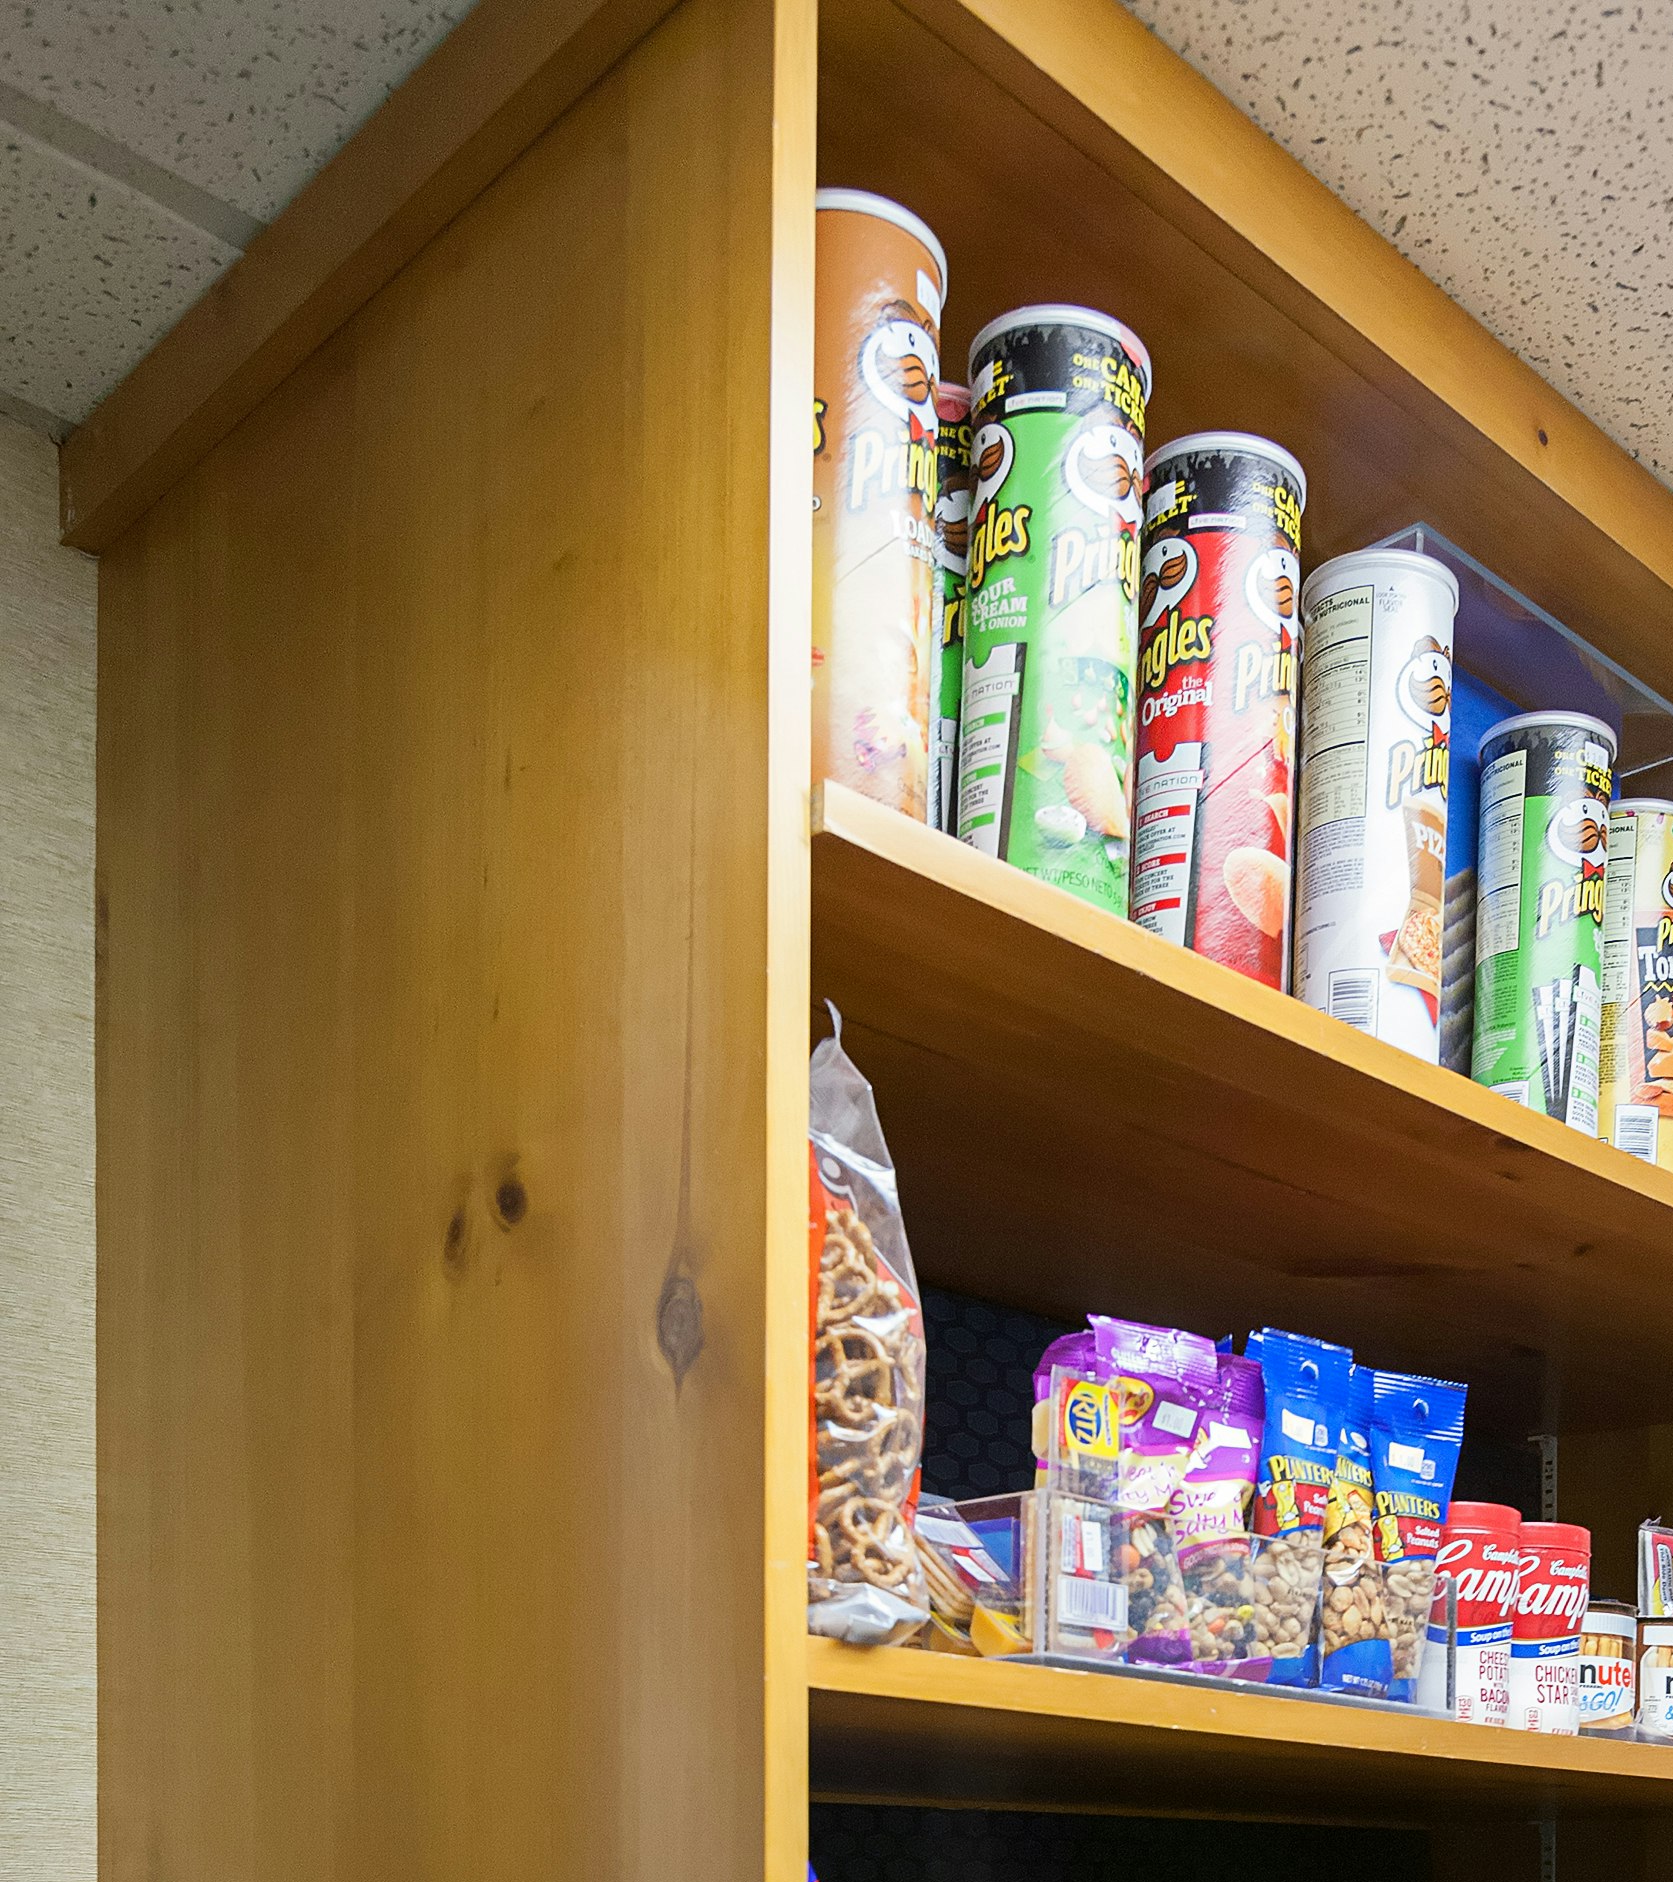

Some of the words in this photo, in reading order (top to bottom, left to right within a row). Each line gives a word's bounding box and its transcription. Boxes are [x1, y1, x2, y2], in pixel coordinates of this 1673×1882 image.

[1182, 675, 1205, 690] the
[1142, 683, 1213, 725] Original
[1073, 1393, 1101, 1446] RITZ
[1376, 1490, 1441, 1520] PLANTERS
[1470, 1629, 1490, 1644] Soup
[1538, 1642, 1560, 1657] Soup
